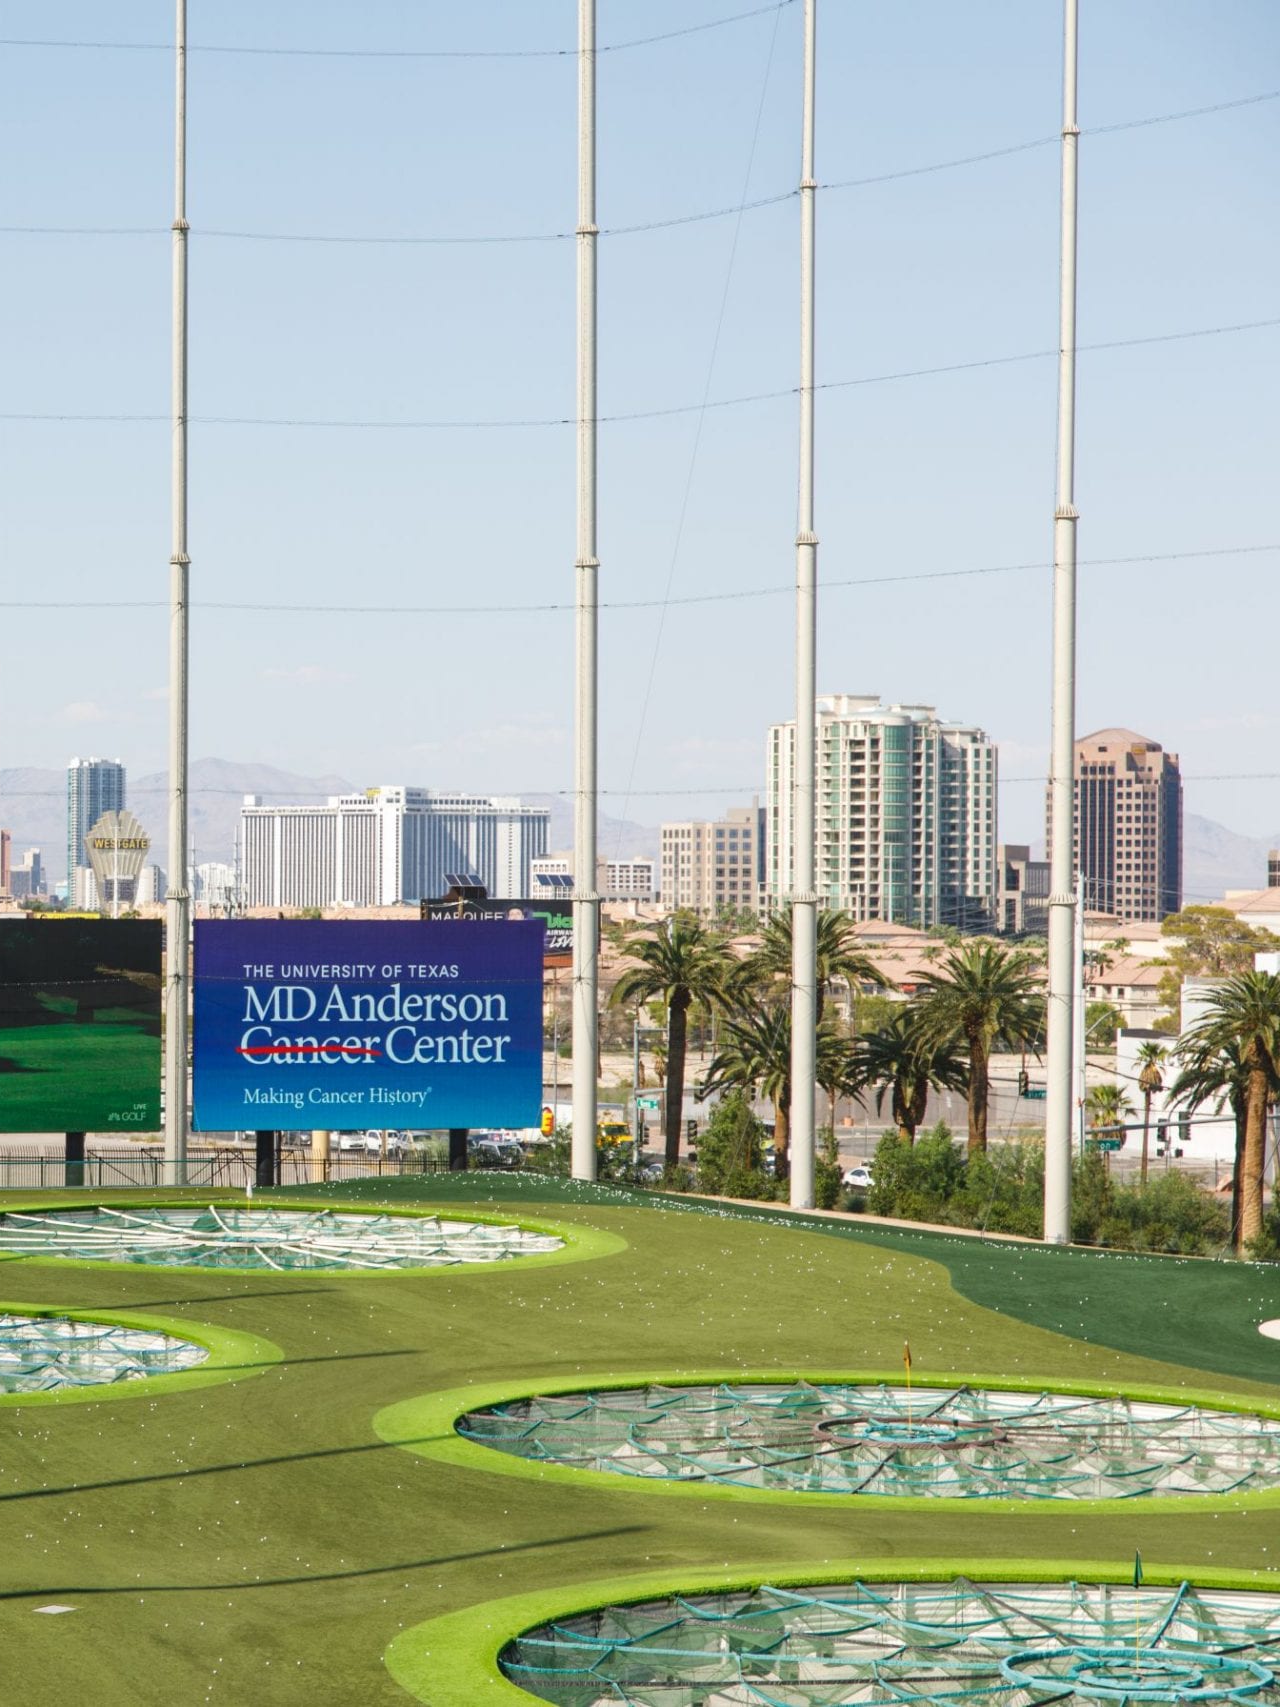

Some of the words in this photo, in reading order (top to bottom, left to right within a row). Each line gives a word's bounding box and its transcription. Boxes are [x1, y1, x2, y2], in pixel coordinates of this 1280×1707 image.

[94, 838, 148, 849] WESTGATE
[243, 964, 274, 978] THE
[281, 964, 376, 978] UNIVERSITY
[381, 964, 402, 978] OF
[408, 964, 459, 978] TEXAS
[241, 986, 316, 1022] MD
[319, 983, 509, 1022] Anderson
[240, 1026, 381, 1064] Cancer
[385, 1026, 511, 1064] Center
[243, 1087, 305, 1108] Making
[308, 1088, 365, 1104] Cancer
[121, 1112, 146, 1121] GOLF
